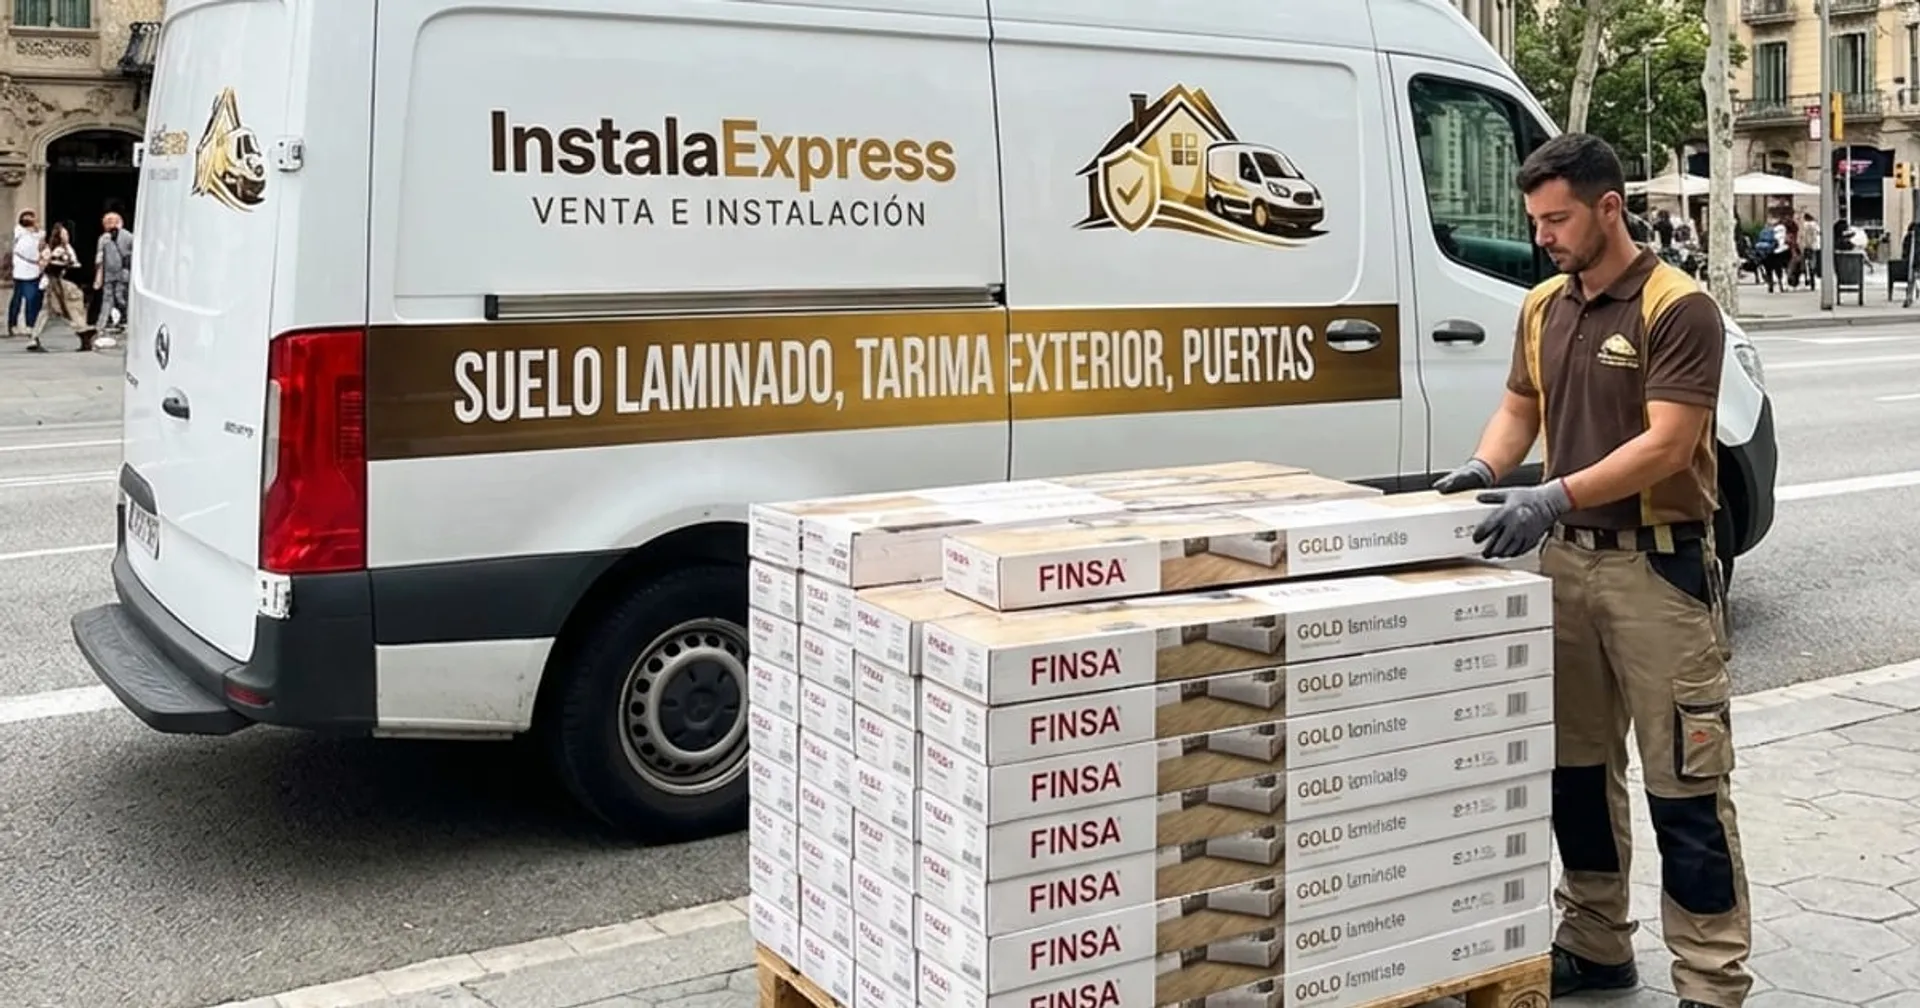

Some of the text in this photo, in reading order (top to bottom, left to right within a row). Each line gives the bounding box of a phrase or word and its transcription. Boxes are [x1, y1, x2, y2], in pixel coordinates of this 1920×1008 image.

[490, 110, 957, 192] InstalaExpress
[531, 195, 926, 227] VENTA E INSTALACIÓN
[453, 325, 1316, 424] SUELO LAMINADO, TARIMA EXTERIOR, PUERTAS
[1039, 558, 1126, 592] FINSA
[1297, 620, 1343, 640] GOLD
[1031, 647, 1121, 686] FINSA
[1297, 673, 1343, 694] GOLD
[1030, 705, 1121, 745] FINSA
[1297, 725, 1343, 746] GOLD
[1031, 761, 1122, 802] FINSA
[1297, 776, 1343, 798] GOLD
[1030, 816, 1121, 858] FINSA
[1297, 826, 1343, 848] GOLD
[1030, 870, 1121, 914] FINSA
[1296, 875, 1342, 899] GOLD
[1030, 925, 1121, 971] FINSA
[1295, 926, 1341, 950] GOLD
